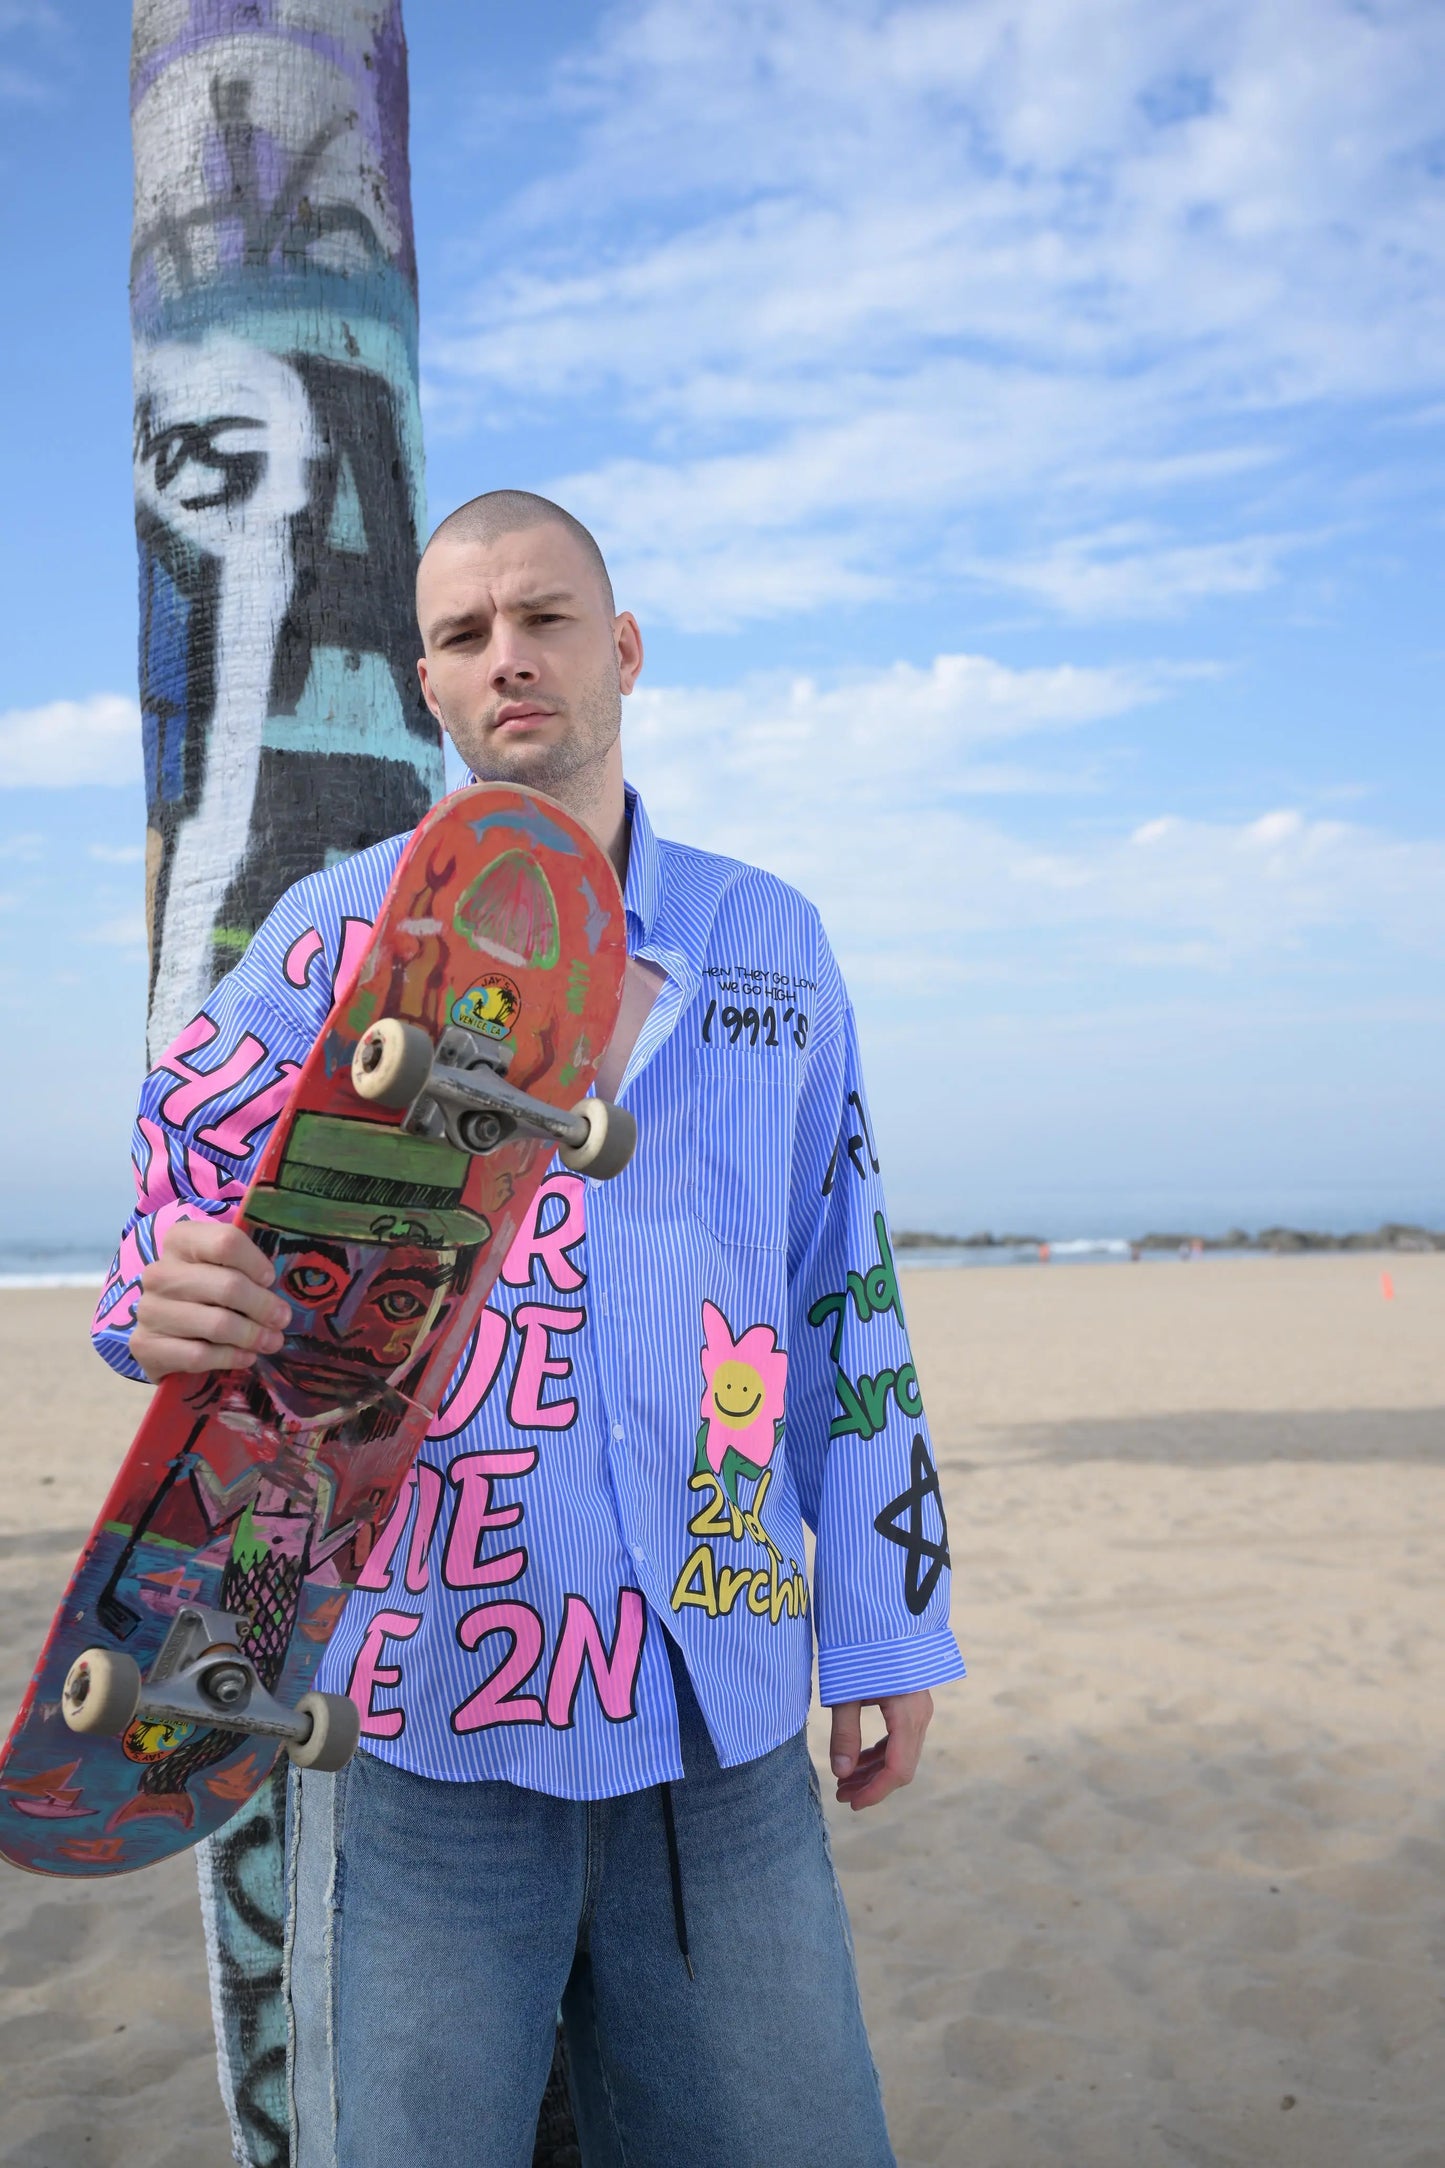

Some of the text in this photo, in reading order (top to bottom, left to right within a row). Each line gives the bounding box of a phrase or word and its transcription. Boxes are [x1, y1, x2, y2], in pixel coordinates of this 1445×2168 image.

[481, 976, 510, 991] JAY'S
[772, 972, 790, 985] GO
[793, 976, 818, 991] LOW
[742, 983, 762, 995] GO
[765, 986, 797, 1002] HIGH
[459, 1015, 501, 1036] VENICE CA
[450, 1586, 647, 1737] 2N
